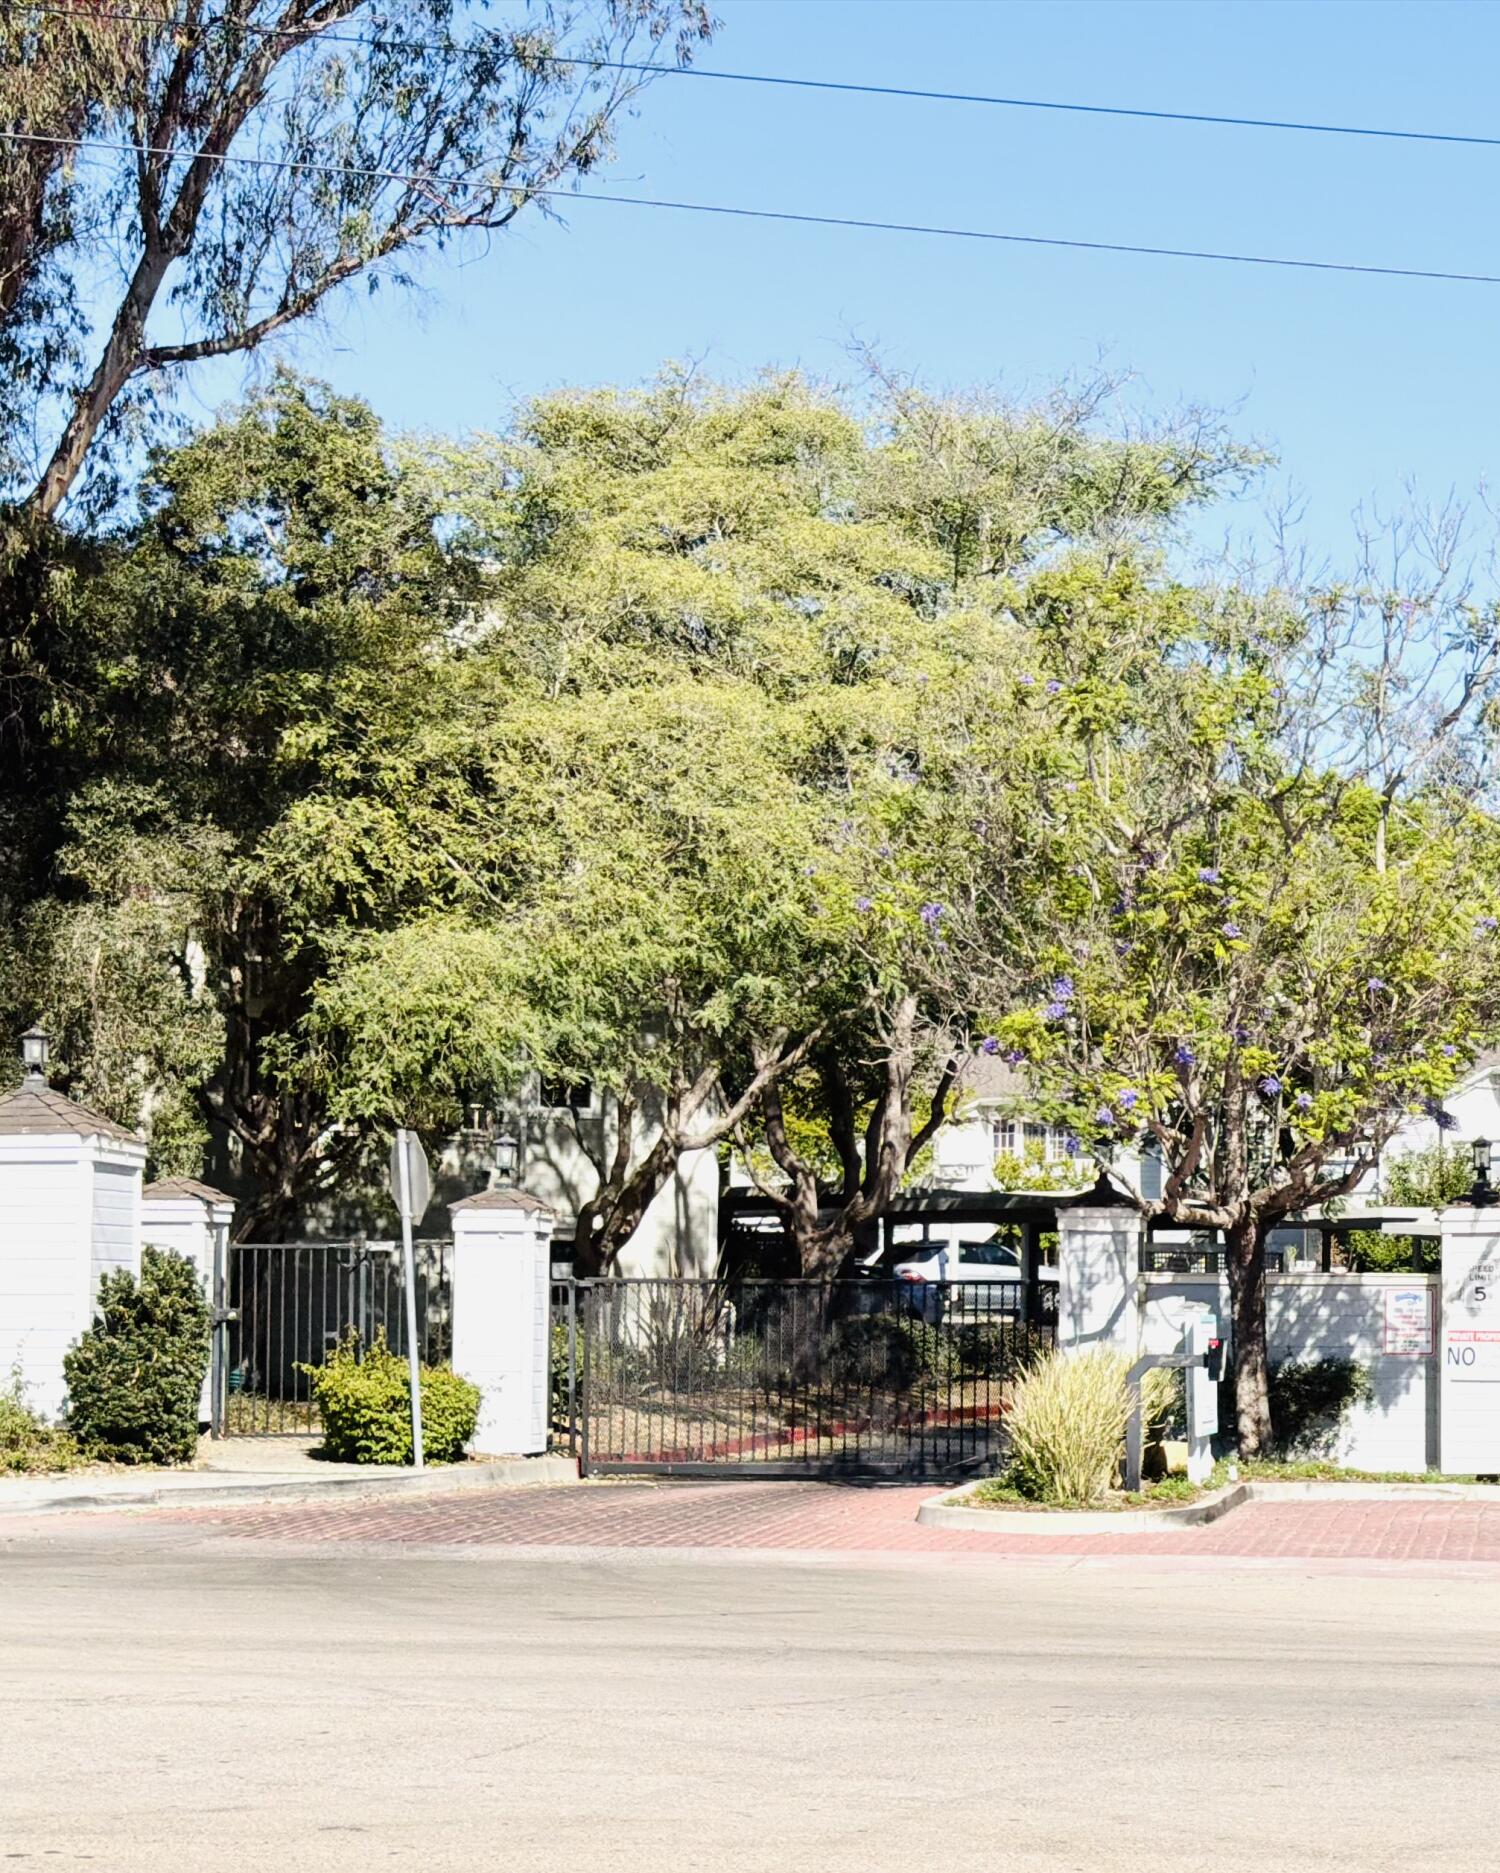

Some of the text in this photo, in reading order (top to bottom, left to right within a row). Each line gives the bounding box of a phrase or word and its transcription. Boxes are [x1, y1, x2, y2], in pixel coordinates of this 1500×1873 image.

[1469, 1265, 1494, 1273] PEED
[1474, 1287, 1486, 1301] 5
[1447, 1346, 1476, 1366] NO
